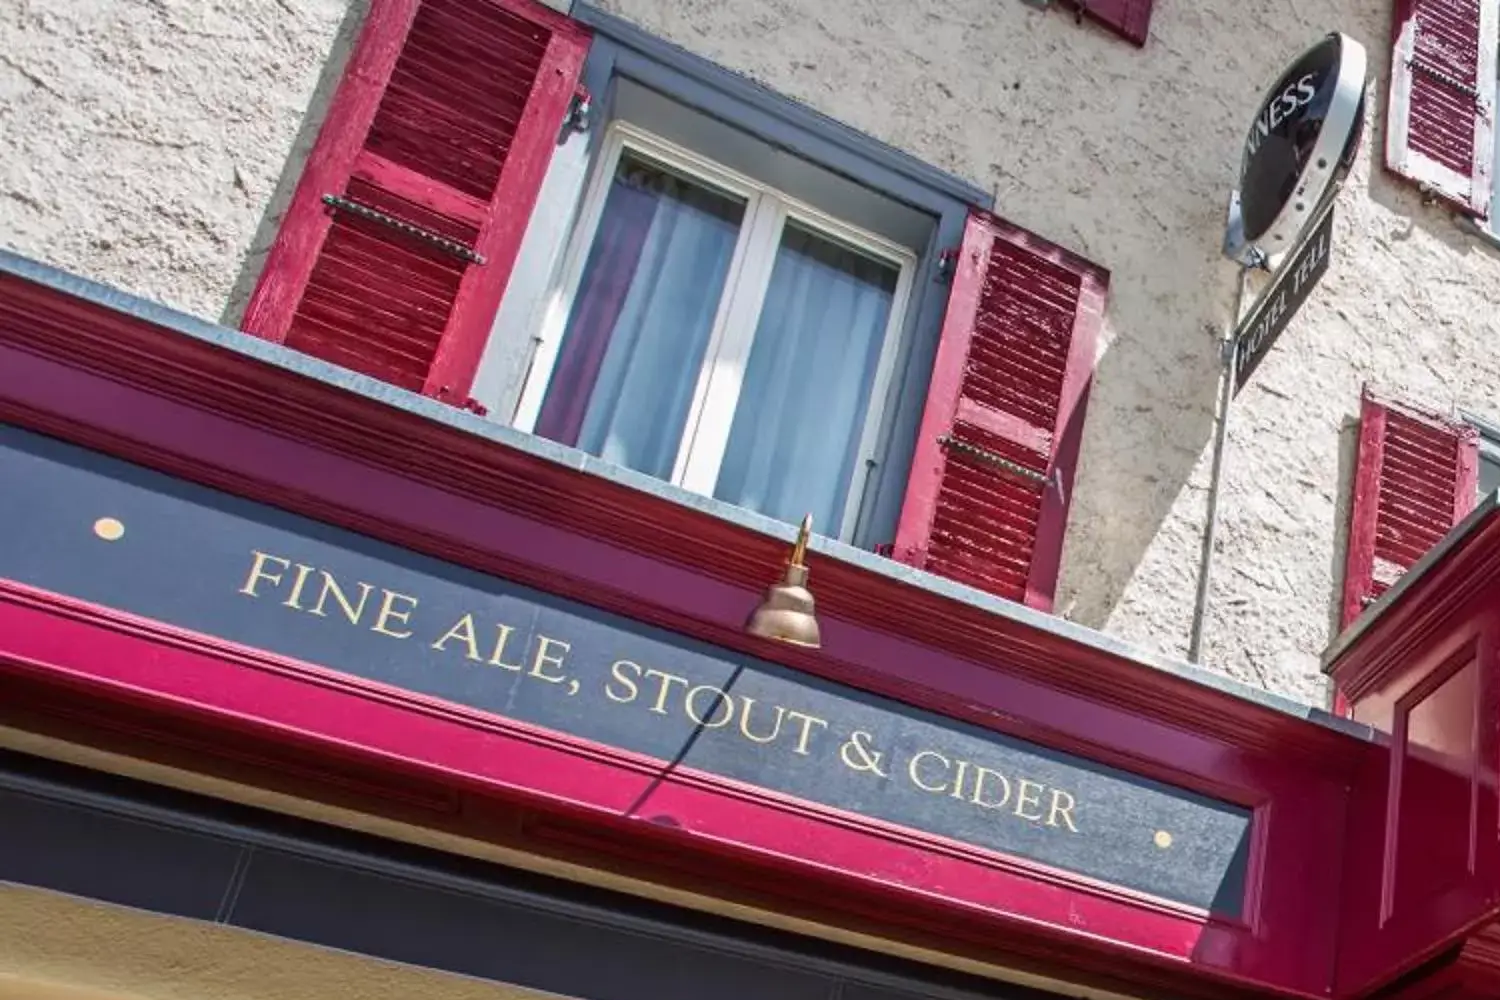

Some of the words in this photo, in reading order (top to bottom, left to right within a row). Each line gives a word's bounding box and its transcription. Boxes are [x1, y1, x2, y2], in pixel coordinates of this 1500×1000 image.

[1245, 73, 1316, 157] NNESS
[1240, 291, 1287, 371] HOTEL
[1294, 234, 1327, 295] TELL
[239, 549, 419, 640] FINE
[432, 612, 580, 697] ALE,
[604, 659, 827, 755] STOUT
[840, 730, 887, 778] &
[909, 749, 1080, 834] CIDER
